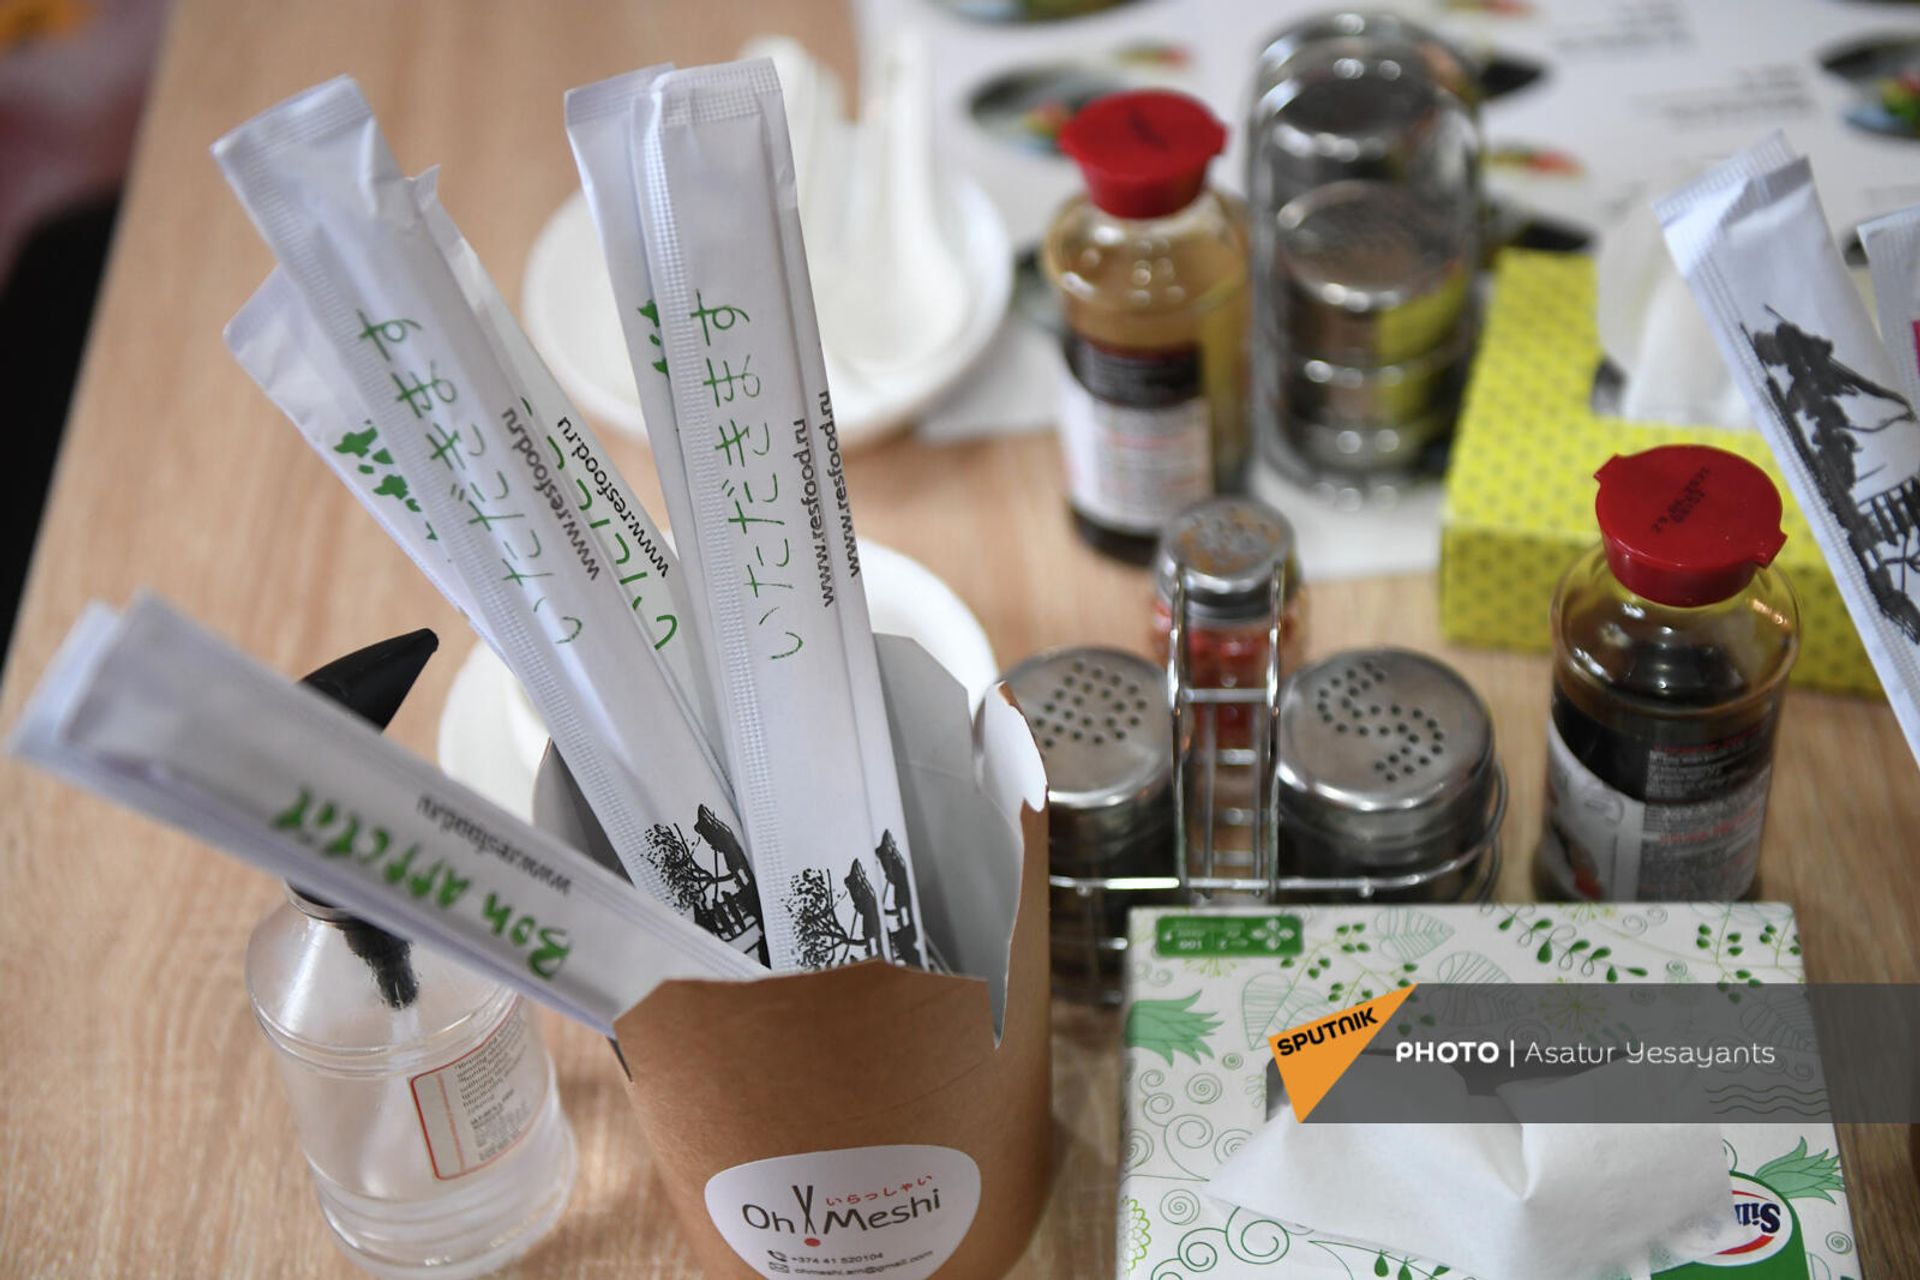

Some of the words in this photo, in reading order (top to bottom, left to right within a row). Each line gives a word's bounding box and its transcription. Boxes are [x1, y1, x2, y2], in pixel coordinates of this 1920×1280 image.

[501, 407, 601, 581] www.resfood.ru
[556, 416, 669, 578] www.resfood.ru
[793, 419, 834, 608] www.resfood.ru
[818, 391, 860, 577] www.resfood.ru
[823, 1188, 942, 1234] Meshi
